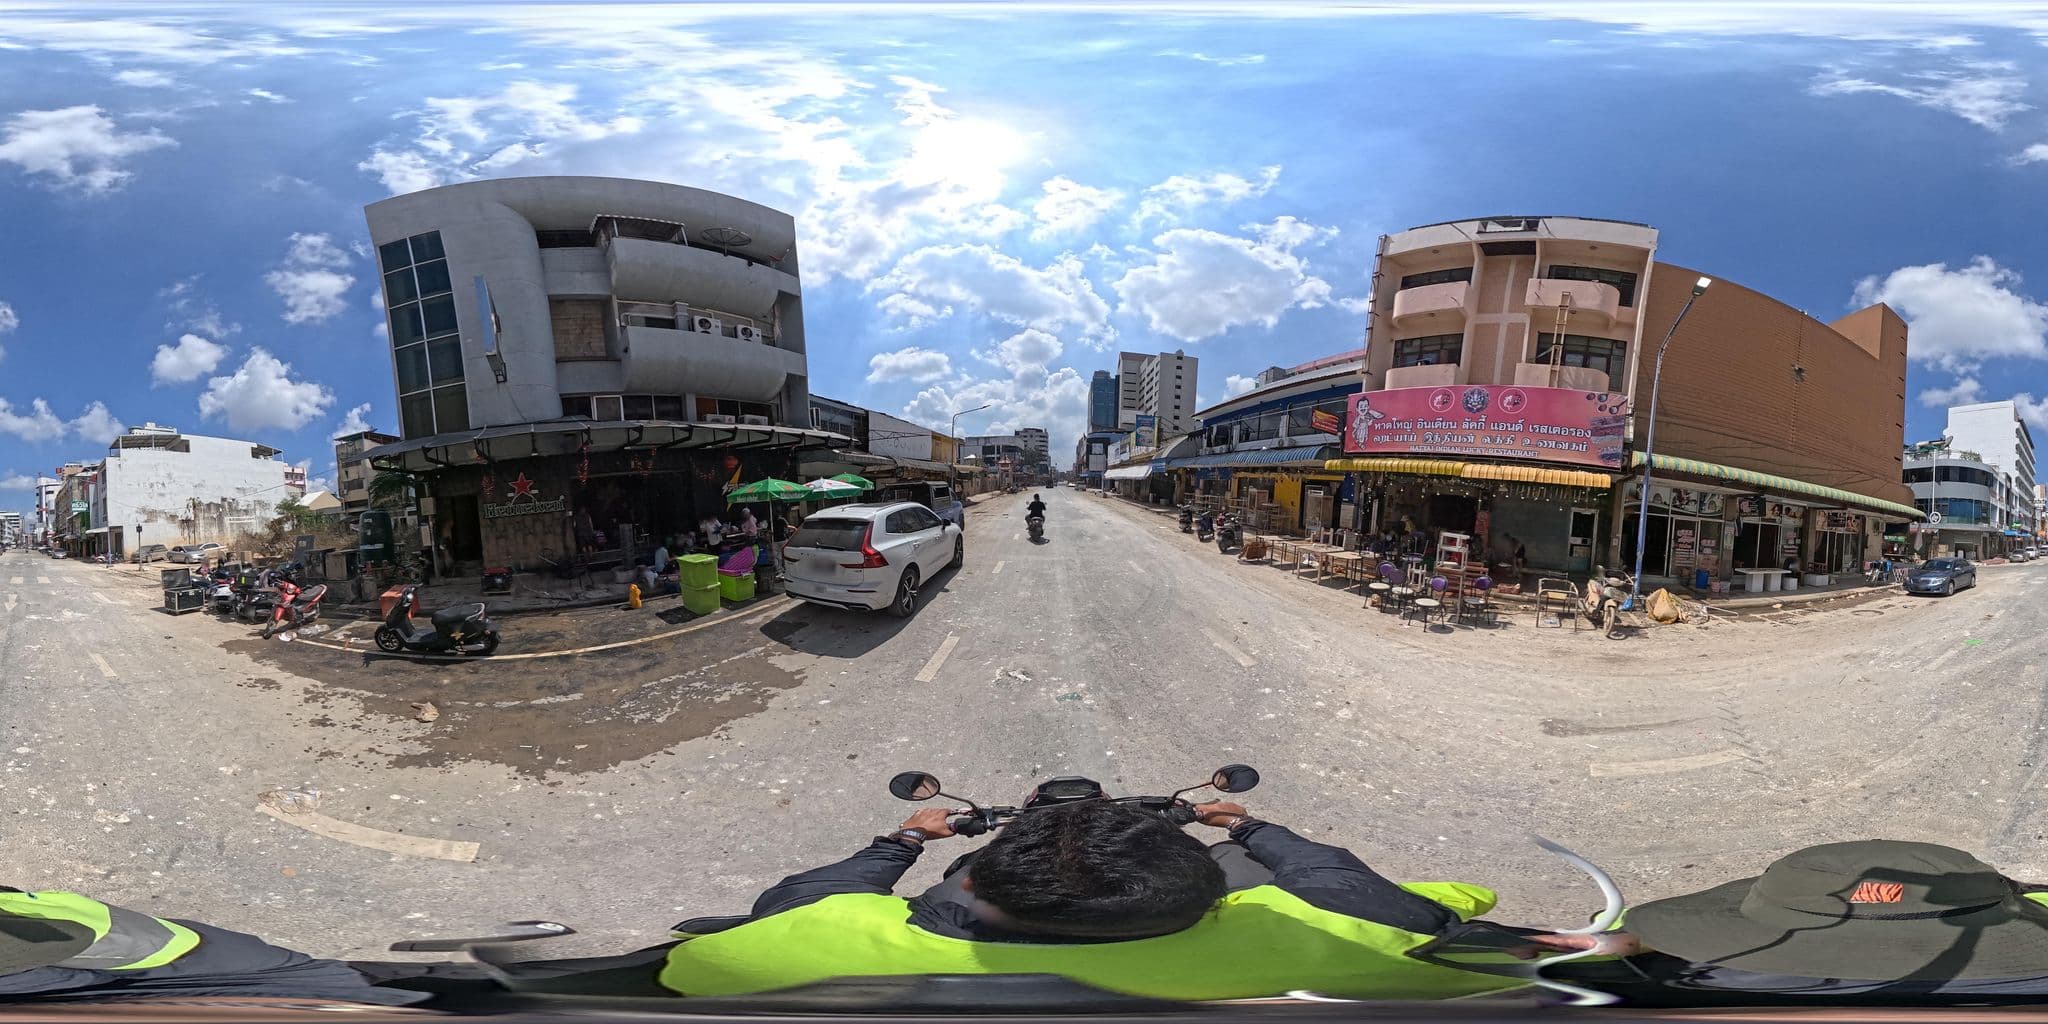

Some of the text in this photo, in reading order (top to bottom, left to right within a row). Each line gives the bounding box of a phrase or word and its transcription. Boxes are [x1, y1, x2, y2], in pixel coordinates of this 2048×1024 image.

[1374, 417, 1413, 432] หาดใหญ่
[1416, 417, 1457, 430] อินเดียน
[1490, 418, 1525, 432] แอนด์
